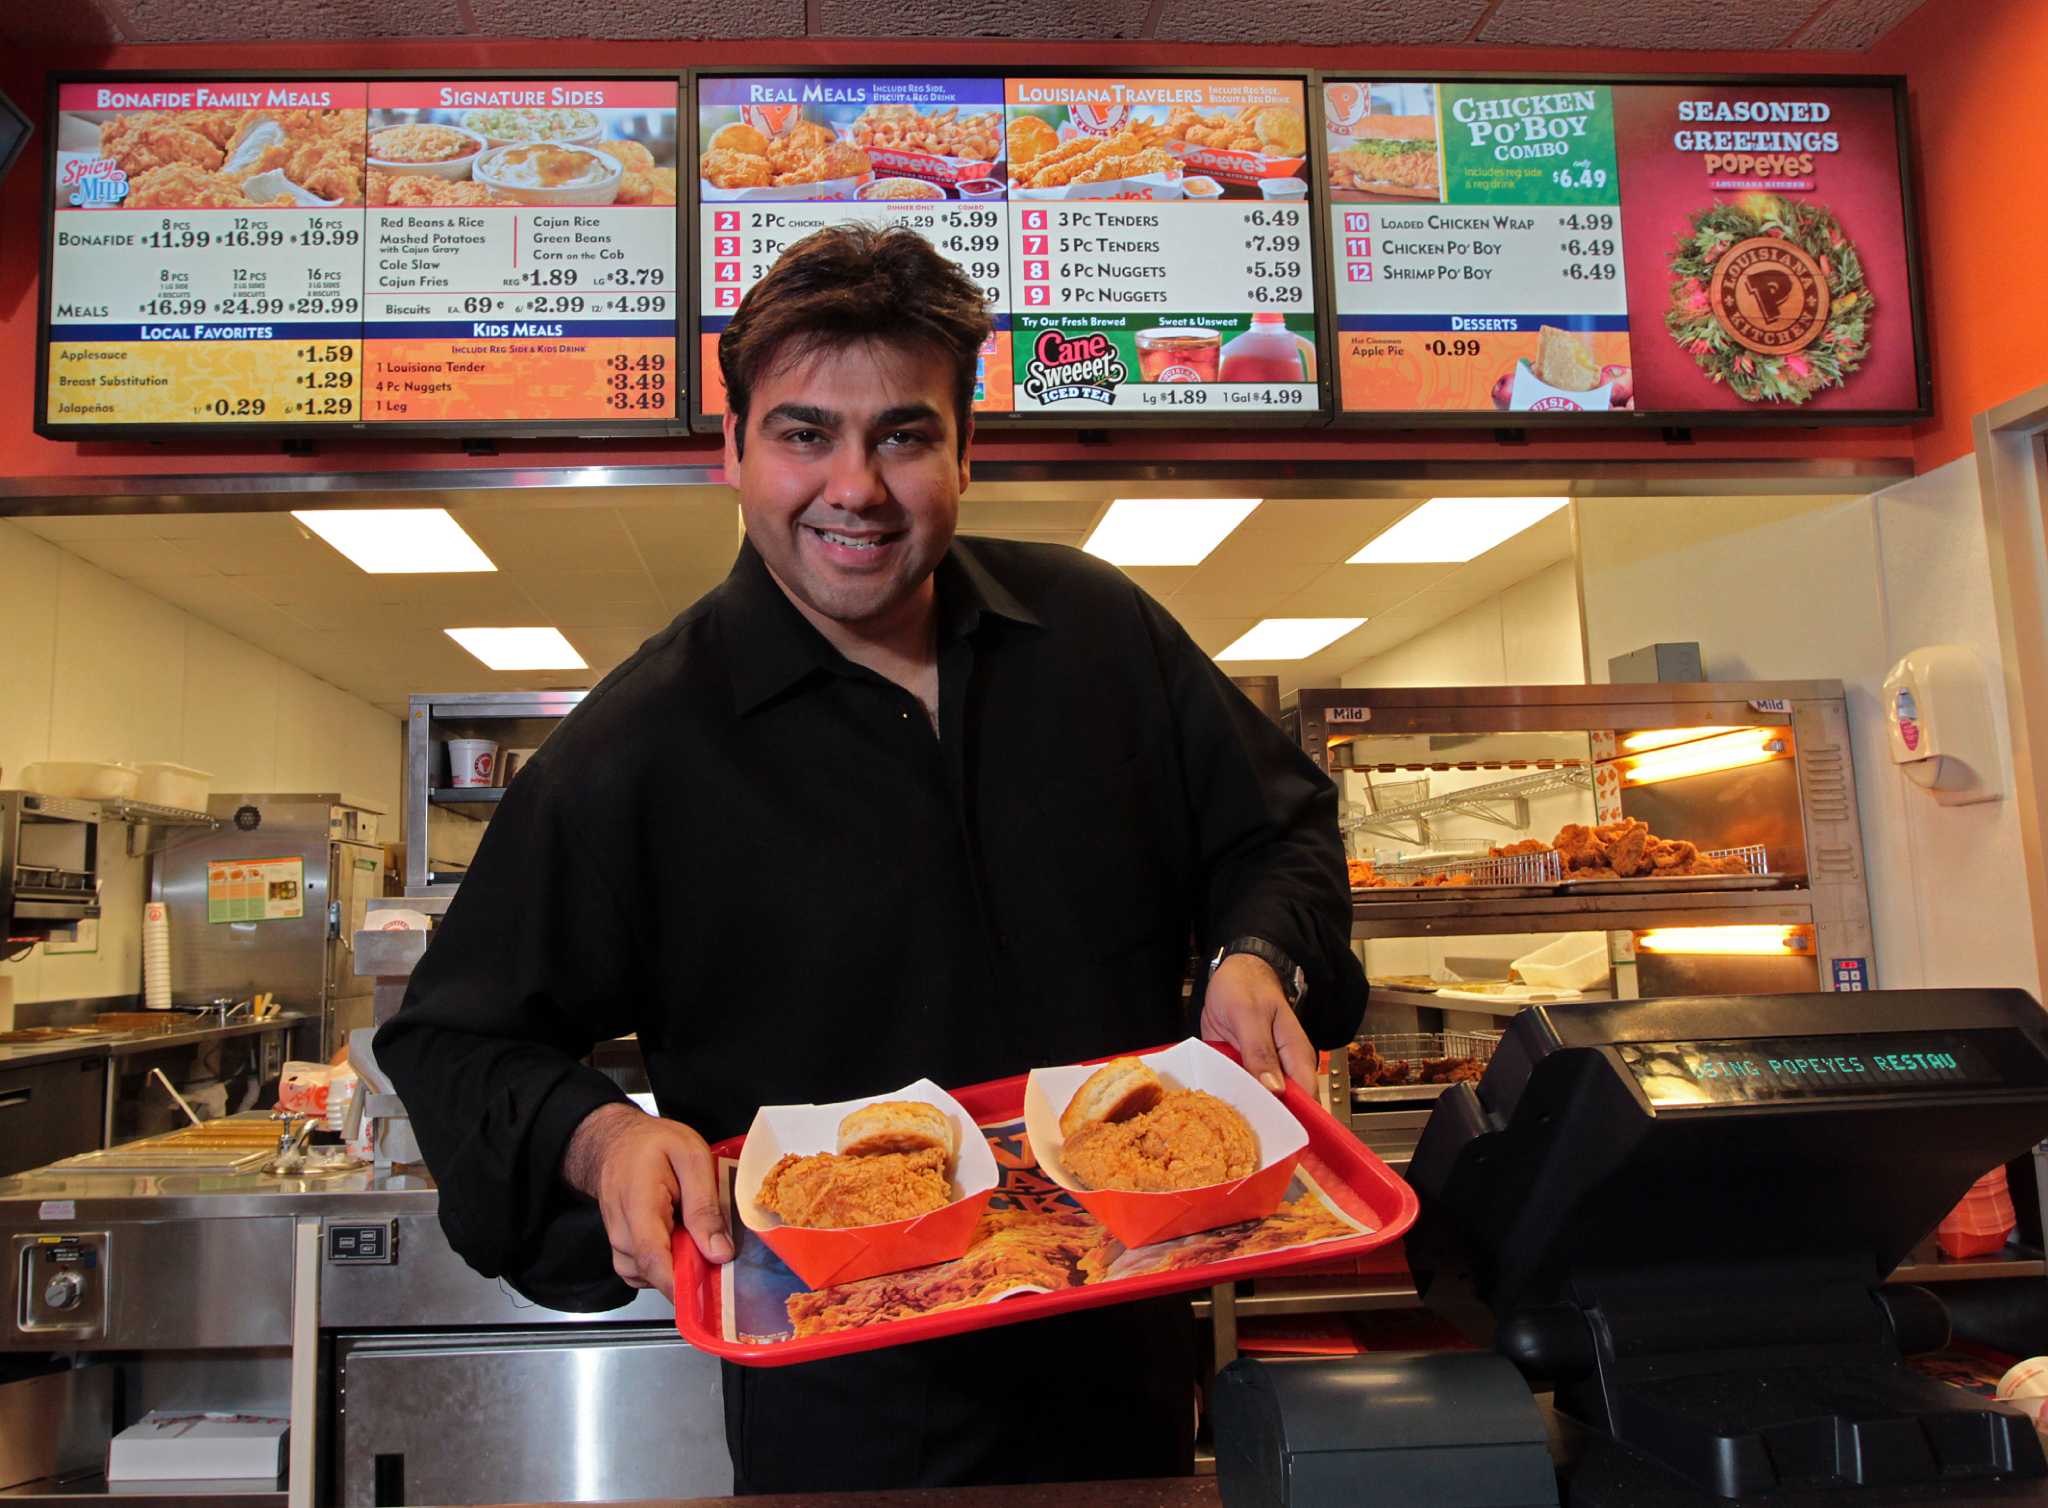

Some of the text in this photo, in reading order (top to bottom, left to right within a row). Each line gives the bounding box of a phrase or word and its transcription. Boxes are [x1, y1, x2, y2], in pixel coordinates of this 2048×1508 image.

[750, 84, 866, 102] REAL MEALS
[873, 84, 924, 92] INCLUDE REG
[1019, 84, 1202, 103] LOUISIANA TRAVELERS
[96, 89, 330, 108] BONAFIDE FAMILY MEALS
[440, 88, 604, 106] SIGNATURE SIDES
[1452, 90, 1596, 123] CHICKEN
[1678, 101, 1830, 123] SEASONED
[1674, 131, 1839, 152] GREETINGS
[1494, 142, 1569, 161] COMBO
[62, 158, 114, 185] Spicy
[1465, 167, 1504, 177] Includes
[1552, 169, 1606, 188] $6.49
[161, 219, 191, 230] 8 PCS
[234, 218, 268, 230] 12 PCS
[308, 217, 343, 229] 16 PCS
[380, 217, 485, 228] Red Beans Rice
[533, 216, 600, 228] Cajun Rice
[720, 213, 734, 230] 2
[752, 213, 762, 228] 2
[941, 211, 998, 228] $5.99
[1027, 210, 1300, 227] 6 3 TENDERS $6.49
[1346, 214, 1367, 231] 10
[1381, 217, 1423, 229] LOADED
[1427, 215, 1489, 229] CHICKEN
[1493, 216, 1534, 229] WRAP
[58, 232, 134, 246] BONAFIDE
[380, 234, 486, 245] Mashed Potatoes
[533, 234, 612, 244] Green Beans
[721, 236, 999, 254] 3 3 $6.99
[1028, 236, 1301, 253] 7 5 TENDERS $7.99
[380, 245, 460, 255] with Cajun Gravy
[533, 250, 563, 260] Corn
[580, 252, 596, 260] the
[600, 249, 625, 260] Cob
[1347, 240, 1368, 255] 11
[1382, 241, 1444, 255] CHICKEN
[380, 260, 439, 271] Cole Slaw
[721, 264, 762, 280] 4 3
[1030, 262, 1301, 278] 8 6 NUGGETS $5.59
[1349, 264, 1371, 280] 12
[1384, 265, 1436, 279] SHRIMP
[1723, 247, 1812, 289] LOUISIANA
[160, 270, 189, 281] 8 PCS
[232, 269, 266, 281] 12 PCS
[307, 269, 341, 281] 16 PCS
[503, 269, 665, 287] REG $1.89 $3.79
[379, 276, 449, 289] Cajun Fries
[722, 290, 734, 306] 5
[1030, 286, 1303, 303] 9 9 NUGGETS $6.29
[57, 304, 109, 317] MEALS
[385, 296, 666, 315] Biscuits $2.99 $4.99
[1022, 317, 1126, 327] Try Our Fresh Brewed
[1159, 317, 1238, 326] Sweet Unsweet
[1451, 316, 1518, 331] DESSERTS
[1729, 311, 1815, 346] KITCHEN
[140, 326, 273, 340] LOCAL FAVORITES
[473, 323, 563, 337] KIDS MEALS
[451, 345, 586, 354] INCLUDE REG SIDE KIDS DRINK
[1038, 330, 1107, 366] Cane
[1351, 340, 1480, 356] Apple Pie $0.99
[60, 350, 128, 361] Applesauce
[387, 362, 442, 373] Louisiana
[447, 362, 485, 373] Tender
[59, 376, 96, 386] Breast
[99, 375, 168, 386] Substitution
[376, 381, 383, 391] 4
[387, 381, 401, 391] Pc
[404, 381, 452, 394] Nuggets
[1041, 388, 1111, 405] ICED TEA
[1143, 392, 1157, 404] Lg
[1232, 392, 1251, 403] Gal
[387, 401, 407, 413] Leg
[1757, 699, 1783, 709] Mild
[1334, 708, 1362, 719] Mild
[1769, 1056, 1864, 1074] POPEYES
[1873, 1052, 1956, 1071] RESTAU
